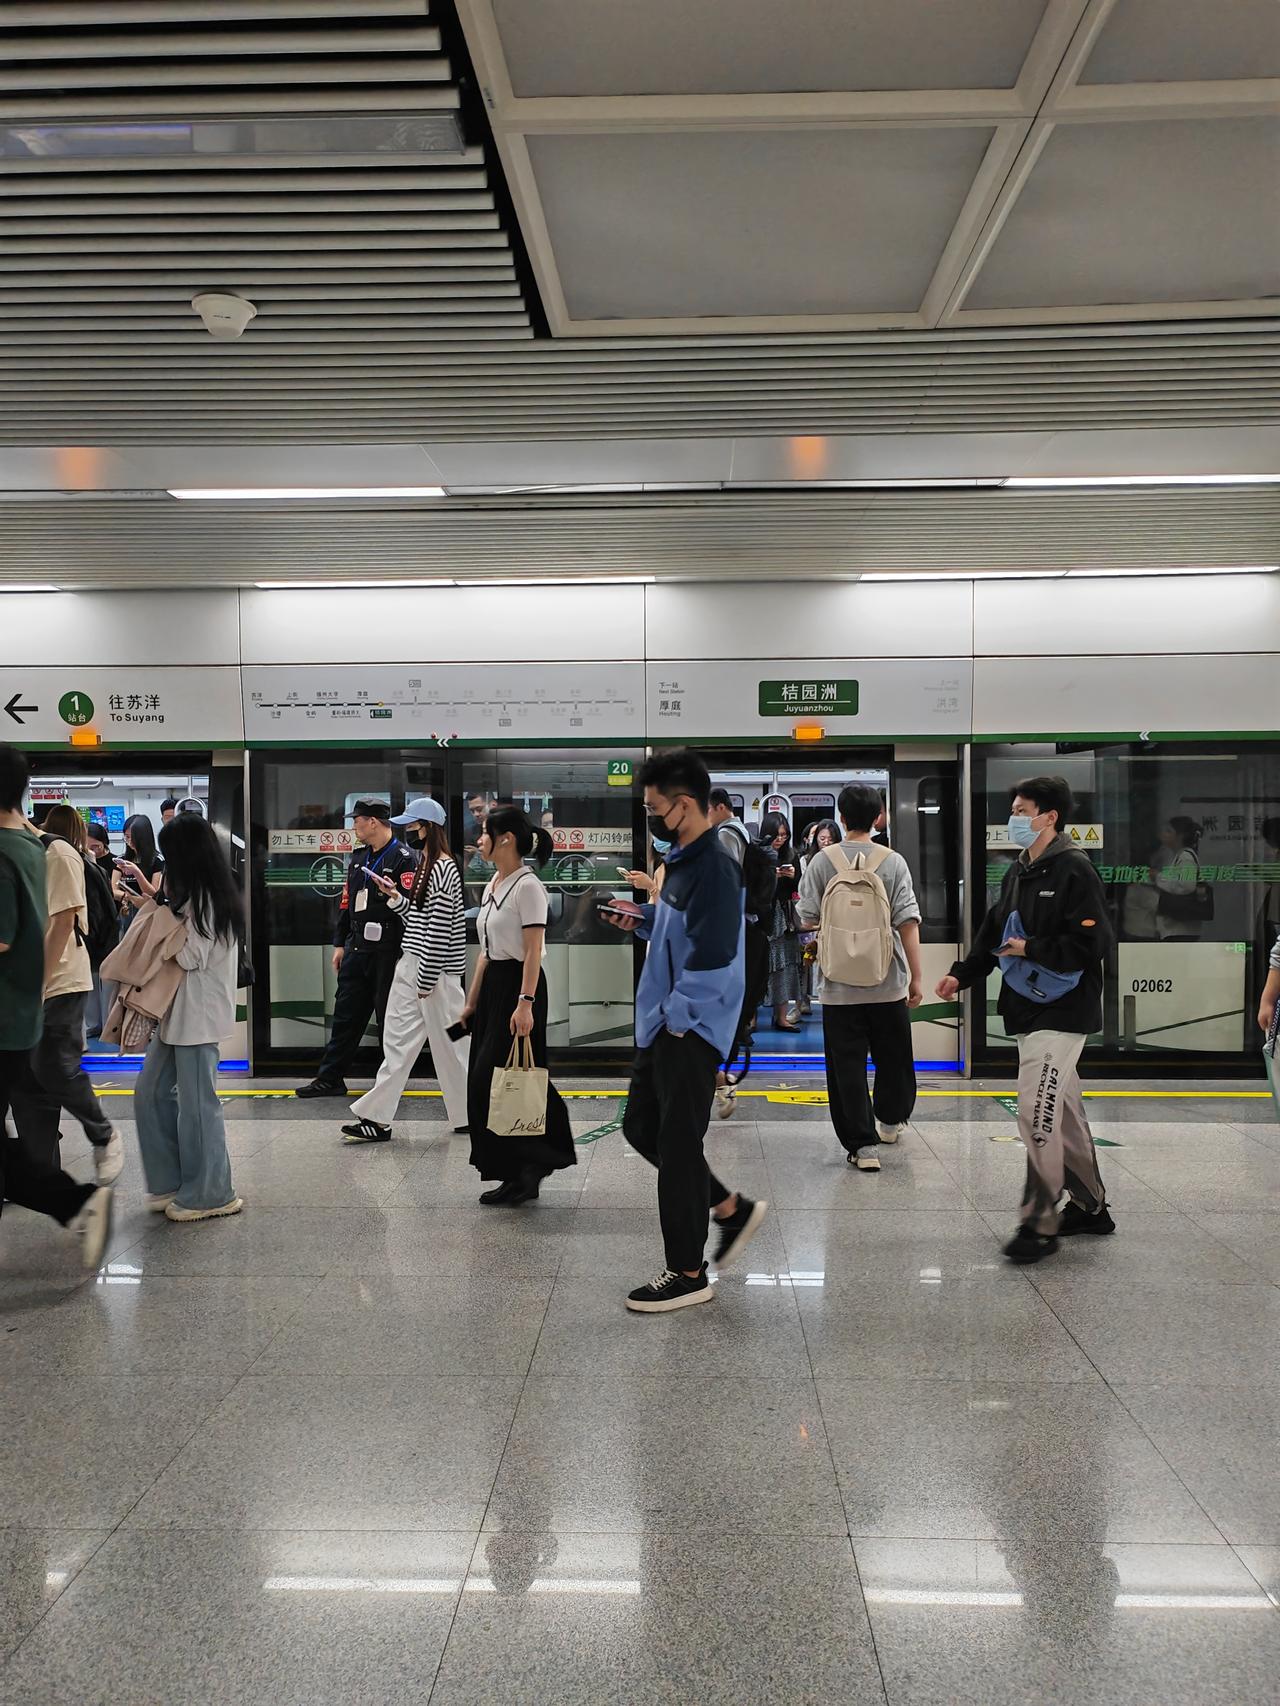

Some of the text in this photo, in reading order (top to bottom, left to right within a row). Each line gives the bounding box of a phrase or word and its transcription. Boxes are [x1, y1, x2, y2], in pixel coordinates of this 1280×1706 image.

[781, 683, 837, 701] 桔园洲
[70, 695, 80, 711] 1
[108, 694, 161, 710] 往苏洋
[659, 700, 681, 711] 厚庭
[784, 704, 834, 714] Juyuanzhou
[67, 713, 86, 722] 站台
[109, 713, 165, 723] To Suyang
[612, 762, 628, 774] 20
[271, 834, 317, 846] 勿上下车
[1132, 979, 1173, 993] 02062
[1042, 1067, 1059, 1134] CALMMIND
